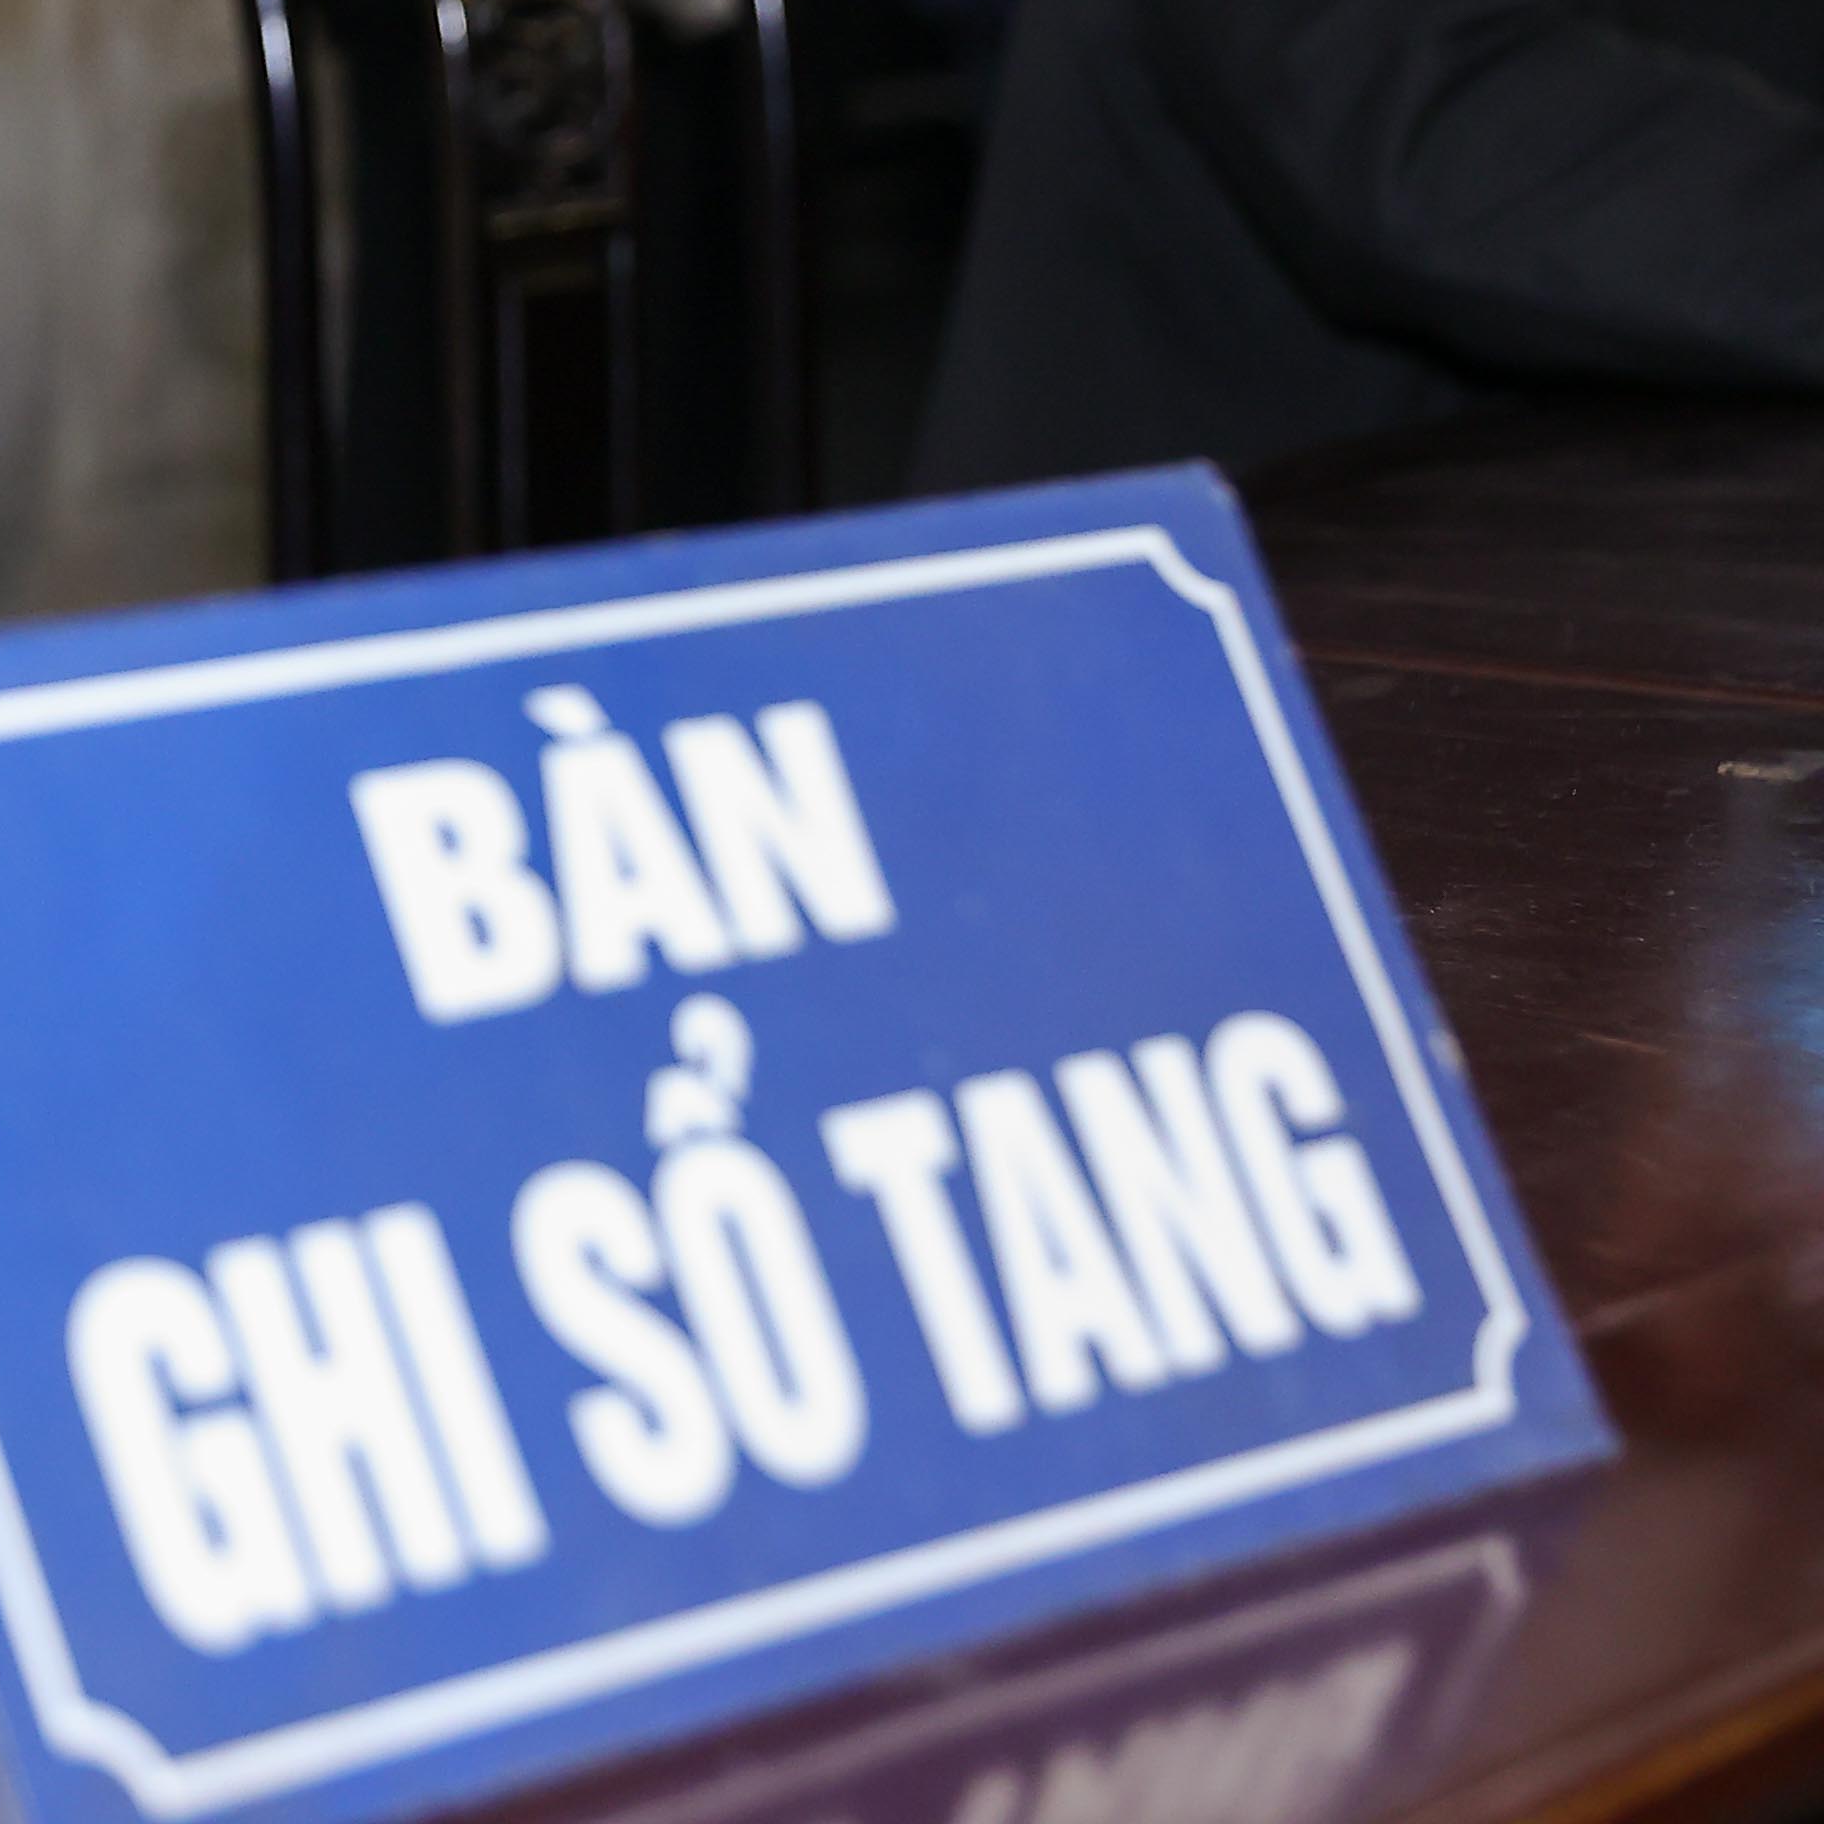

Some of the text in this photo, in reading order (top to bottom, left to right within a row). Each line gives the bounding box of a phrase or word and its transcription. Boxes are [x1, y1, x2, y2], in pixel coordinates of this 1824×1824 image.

[352, 686, 895, 1022] BÀN
[65, 994, 1422, 1654] GHI SỔ TANG
